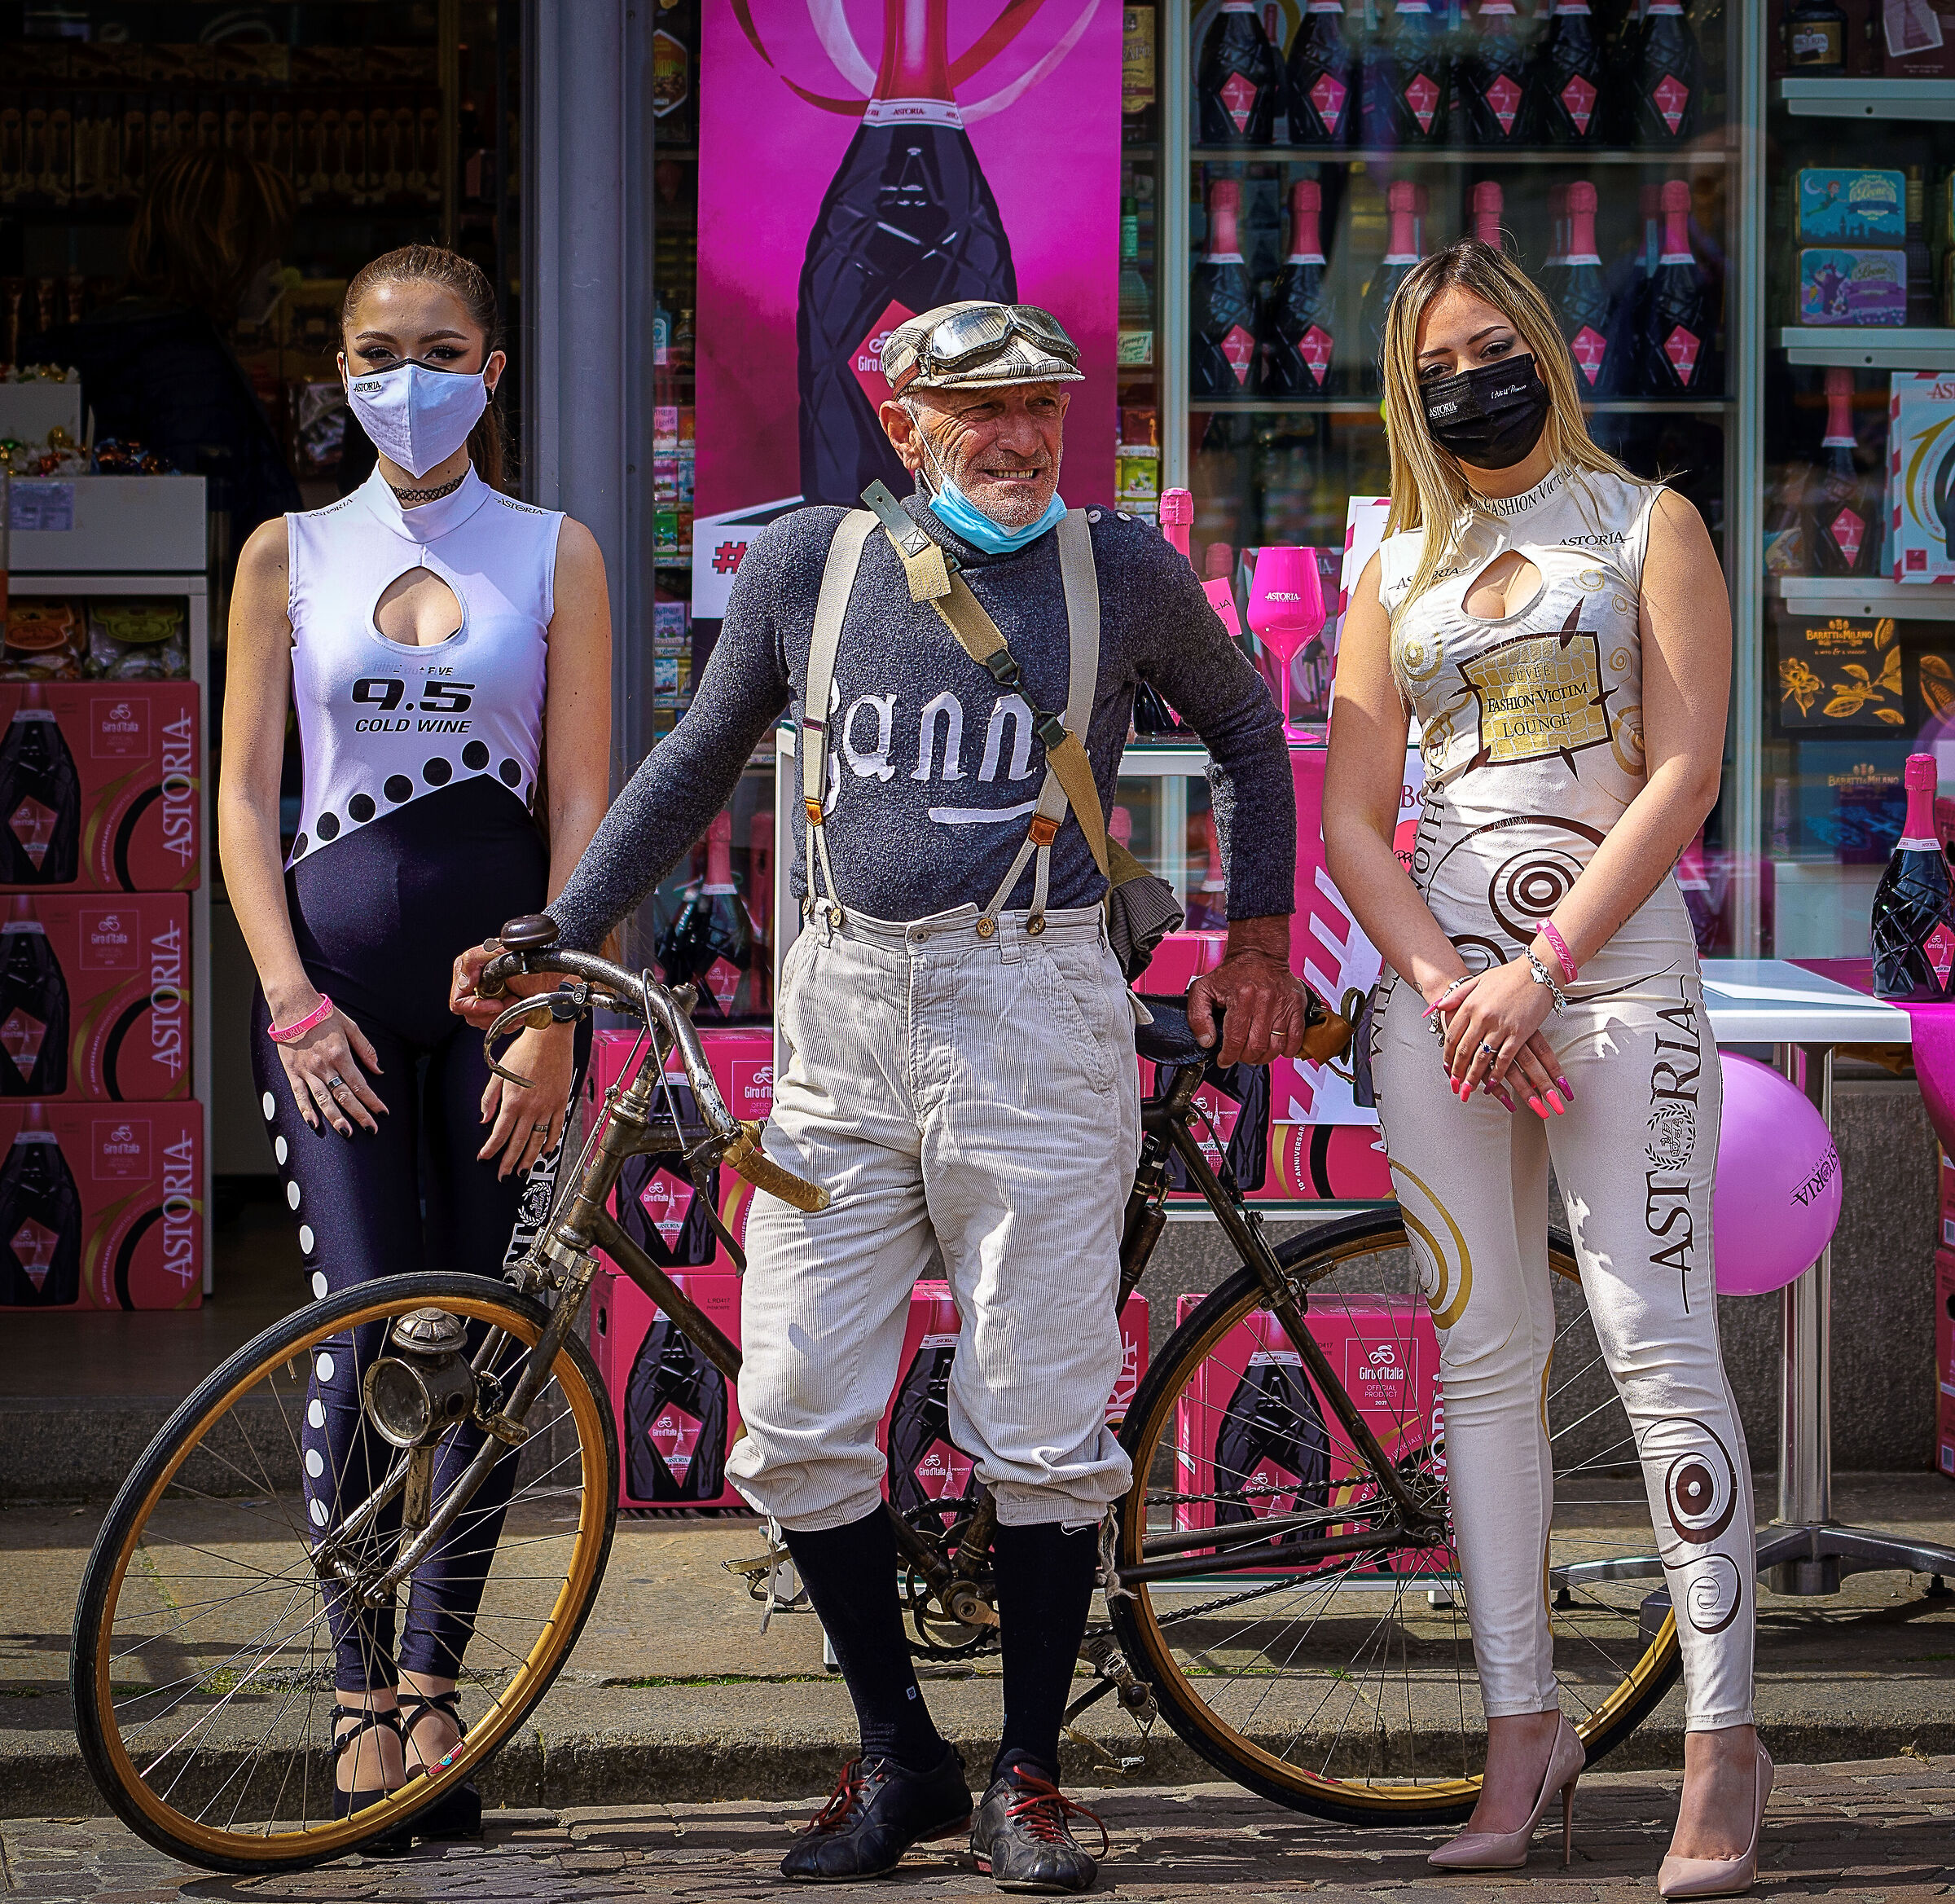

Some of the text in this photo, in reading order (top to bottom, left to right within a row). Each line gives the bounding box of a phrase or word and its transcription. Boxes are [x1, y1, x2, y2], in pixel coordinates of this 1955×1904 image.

[858, 356, 877, 372] Giro
[354, 380, 382, 392] ASTORIA
[1429, 401, 1458, 418] ASTORIA
[305, 496, 358, 518] ASTORIA
[494, 498, 548, 516] ASTORIA
[1558, 531, 1634, 546] ASTORIA
[1264, 591, 1301, 600] ASTORIA
[352, 679, 475, 712] 9.5
[1487, 682, 1589, 713] FASHION VICTIM
[355, 719, 472, 733] COLD WINE
[1503, 711, 1572, 737] LOUNGE
[163, 707, 192, 867] ASTORIA
[152, 920, 182, 1079] ASTORIA
[745, 1085, 760, 1098] Giro
[163, 1130, 193, 1288] ASTORIA
[1360, 1365, 1404, 1380] Giro d'Italia
[919, 1466, 947, 1476] Giro d'Italia
